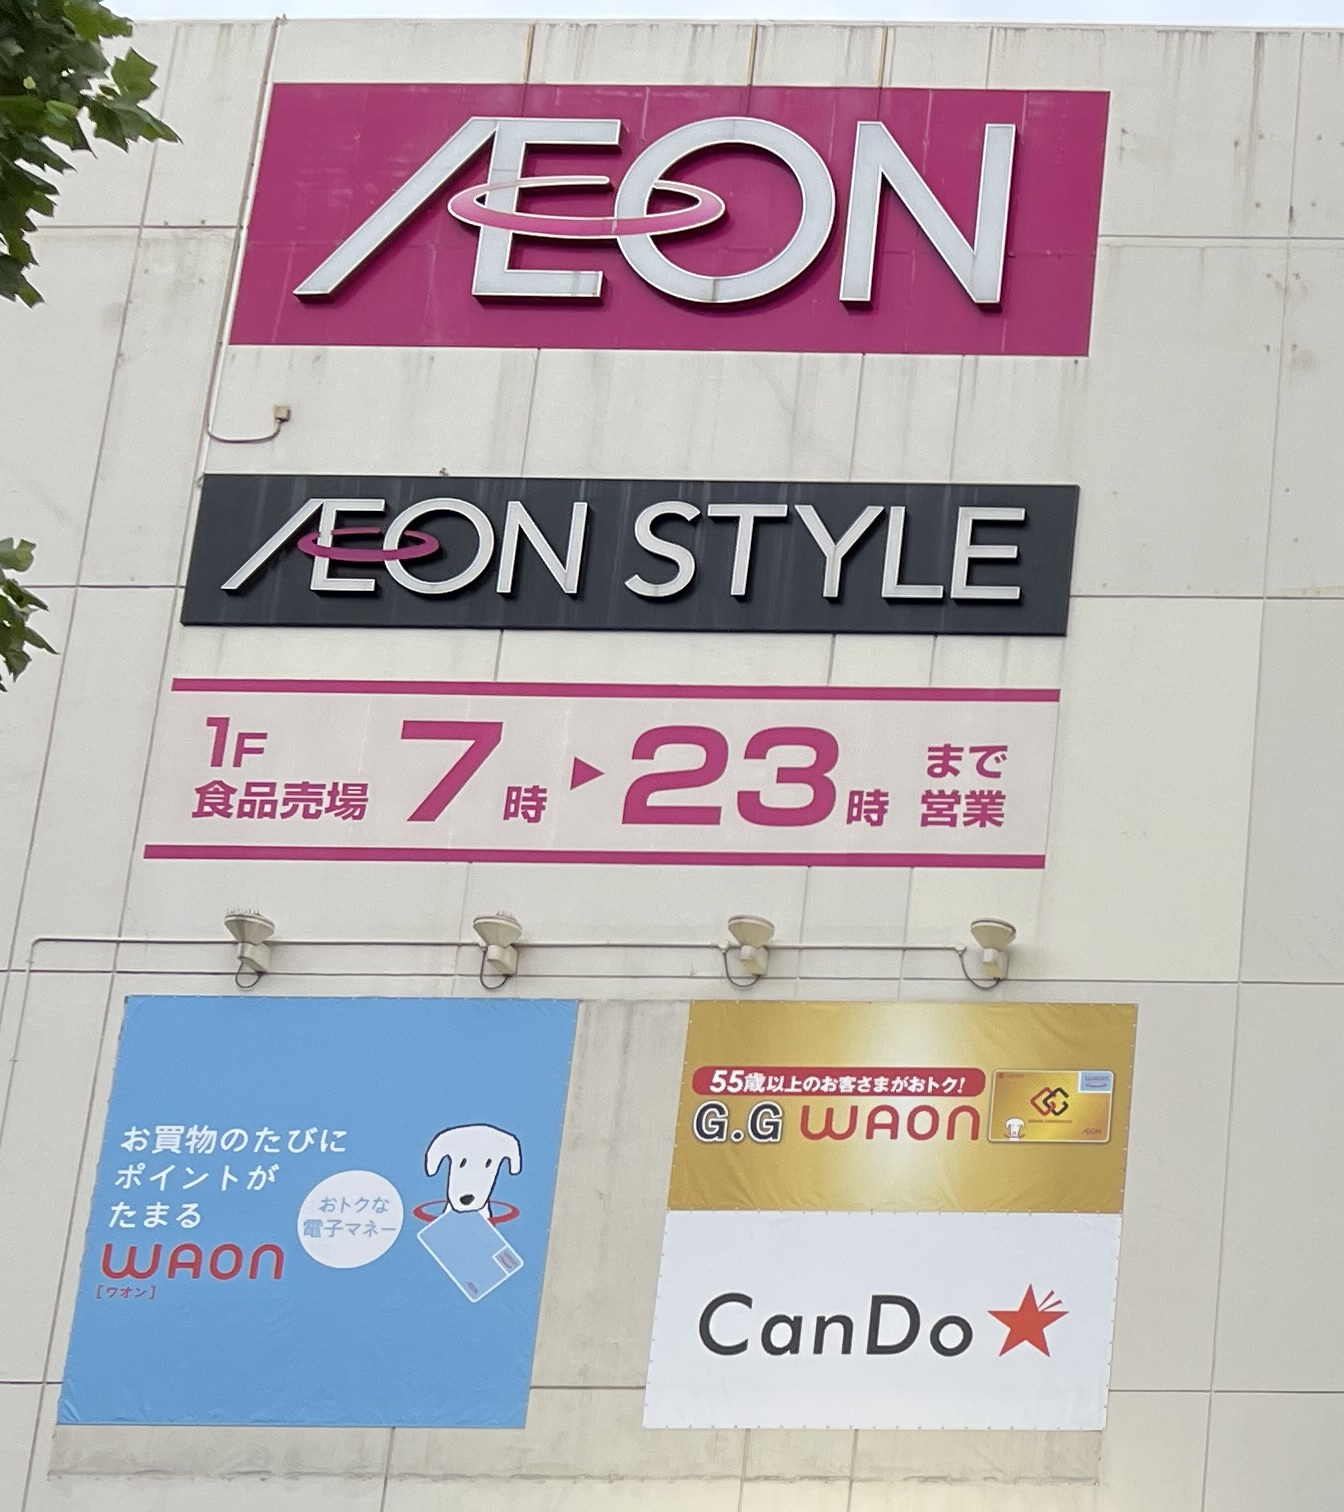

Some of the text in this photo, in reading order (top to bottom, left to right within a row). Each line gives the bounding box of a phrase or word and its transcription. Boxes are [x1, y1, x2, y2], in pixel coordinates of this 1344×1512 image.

[625, 499, 1028, 603] STYLE
[205, 716, 268, 771] 1F
[925, 743, 1008, 780] まで
[191, 780, 369, 823] 食品売場
[920, 789, 1007, 831] 営業
[709, 1069, 967, 1094] 55歳以上のお客さまがおトク!
[120, 1125, 347, 1154] お買物のたびに
[692, 1101, 981, 1143] G.G WAON
[114, 1163, 280, 1191] ポイントが
[108, 1201, 202, 1229] たまる
[318, 1196, 391, 1214] おトクな
[303, 1219, 397, 1238] 電子マネー
[101, 1243, 285, 1280] WAON
[698, 1292, 976, 1360] CanDo
